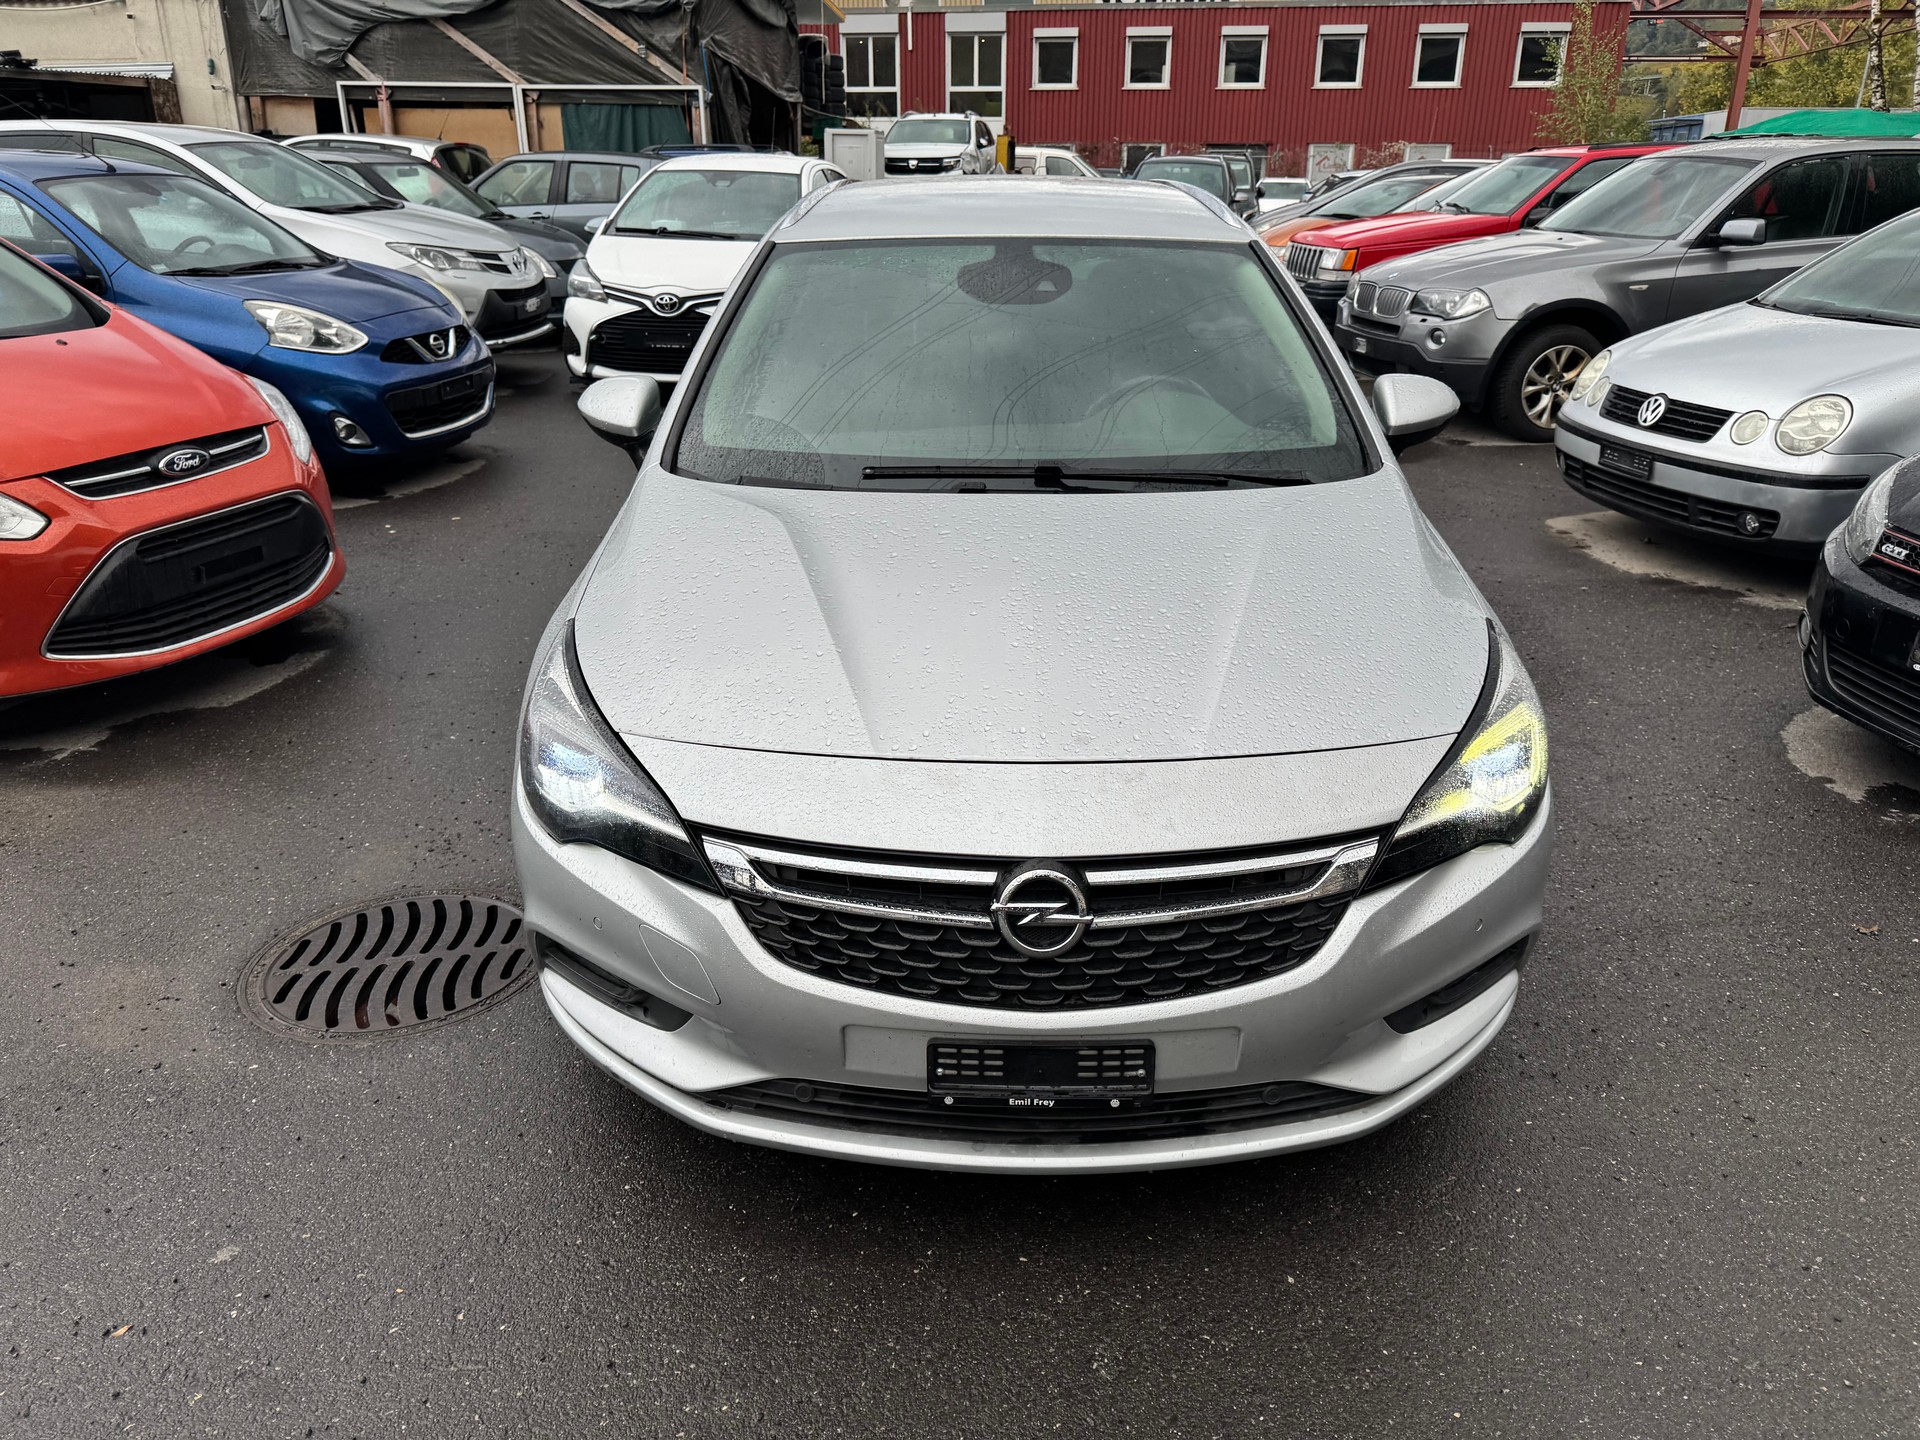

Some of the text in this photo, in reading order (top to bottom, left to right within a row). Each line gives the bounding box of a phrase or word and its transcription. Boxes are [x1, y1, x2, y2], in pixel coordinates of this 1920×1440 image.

[173, 453, 200, 471] Ford
[1881, 543, 1909, 560] GTI
[1009, 1098, 1055, 1108] Emil Frey
